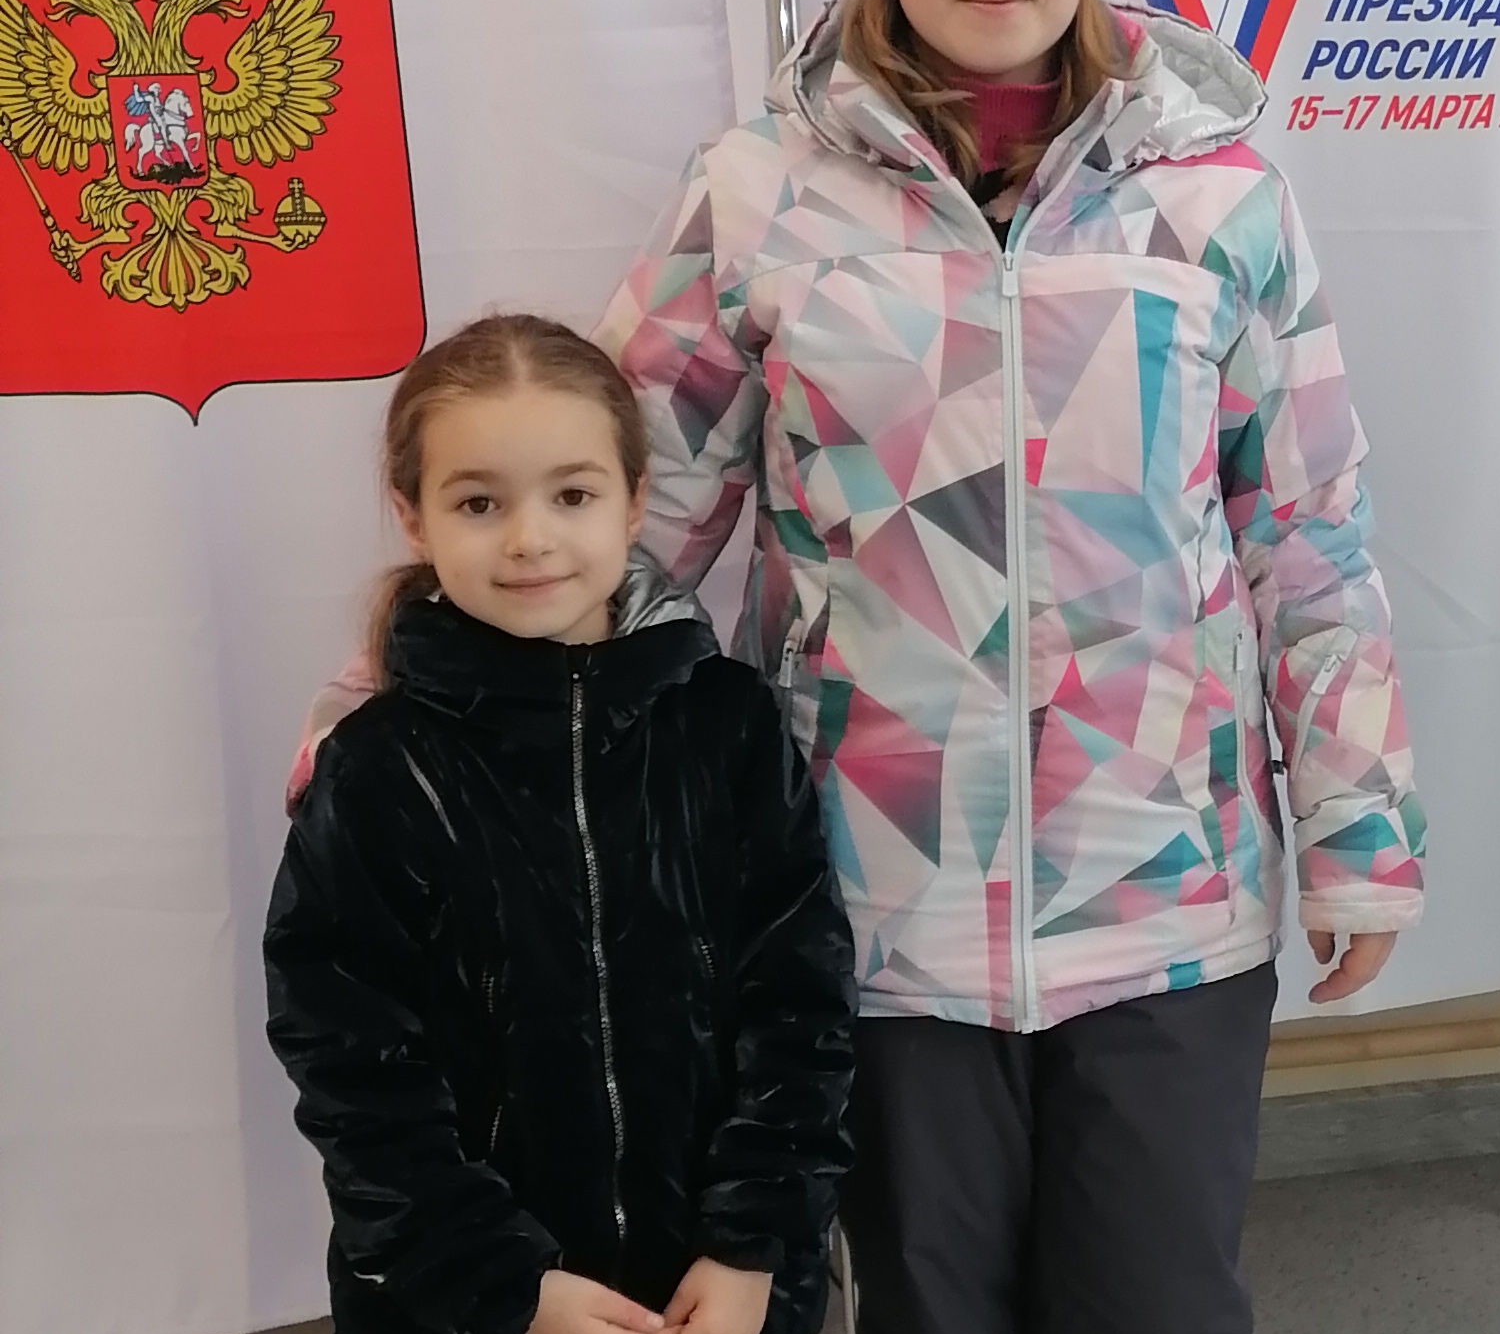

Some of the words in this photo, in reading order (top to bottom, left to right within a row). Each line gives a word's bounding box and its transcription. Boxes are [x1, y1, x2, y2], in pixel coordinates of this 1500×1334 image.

[1302, 37, 1496, 81] РОССИИ
[1286, 94, 1381, 131] 15–17
[1380, 93, 1495, 131] МАРТА
